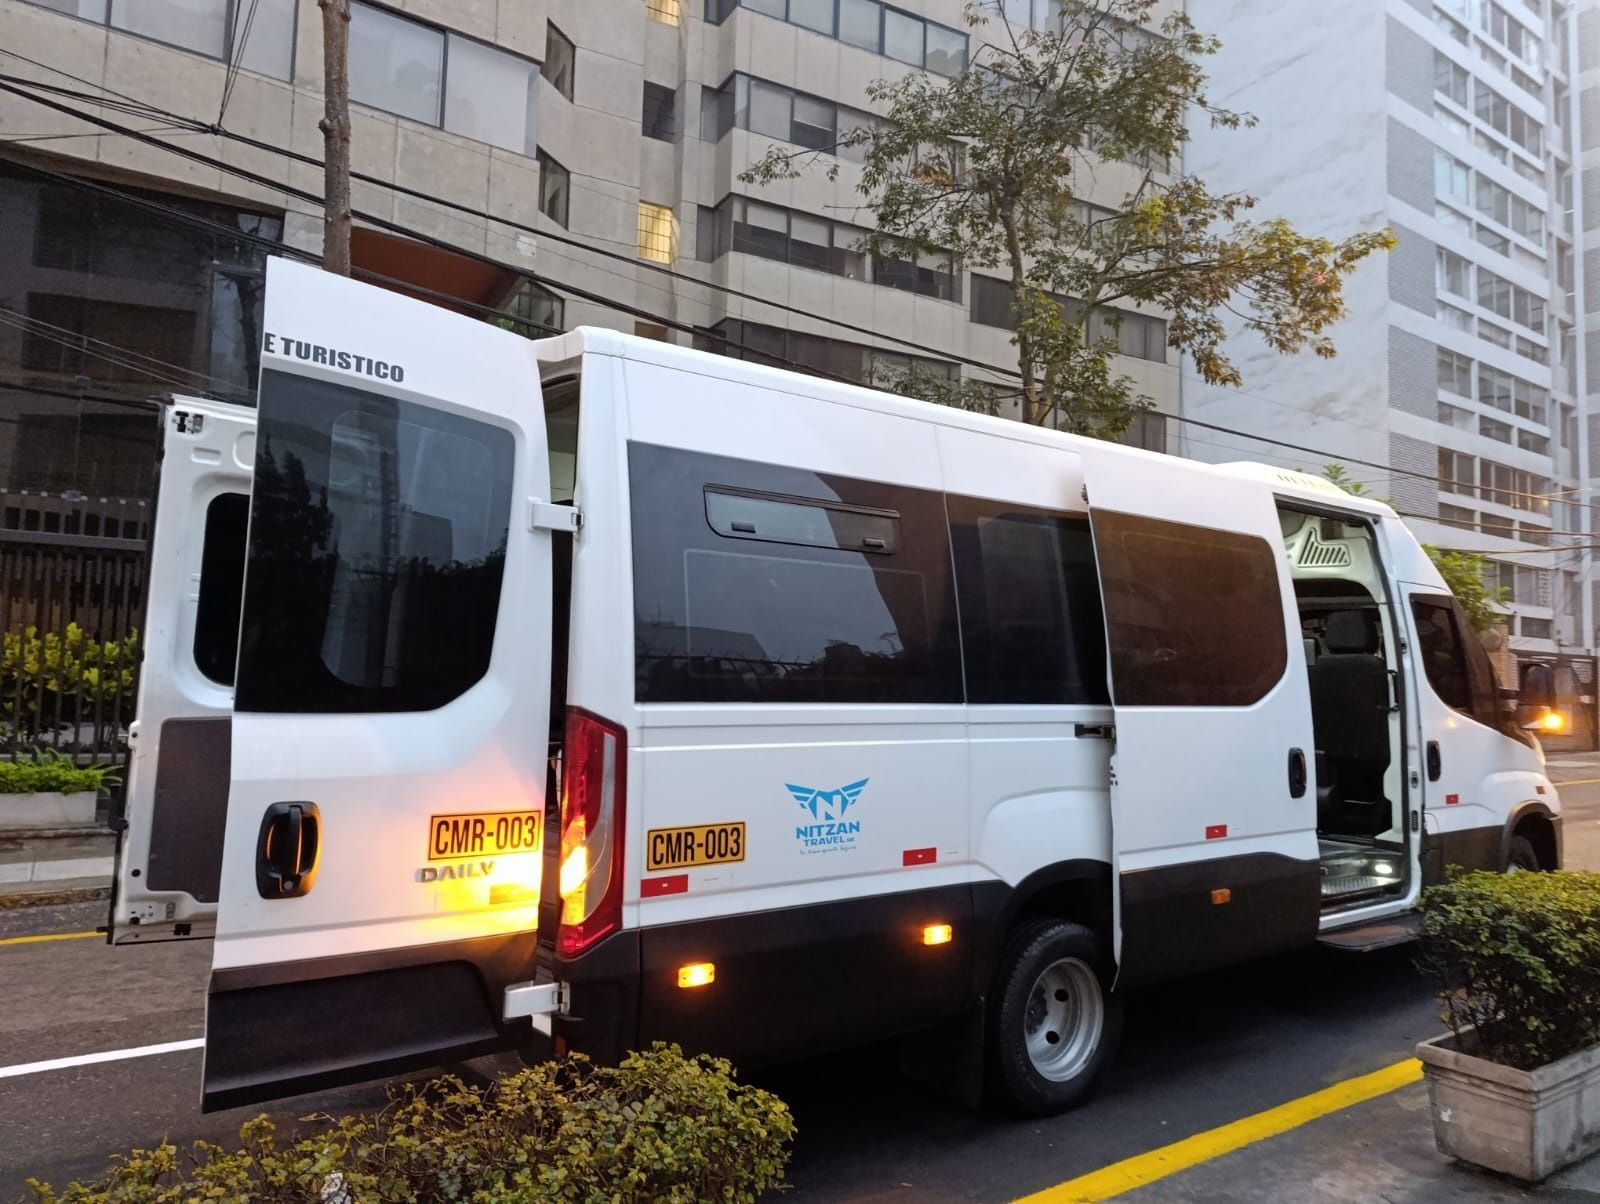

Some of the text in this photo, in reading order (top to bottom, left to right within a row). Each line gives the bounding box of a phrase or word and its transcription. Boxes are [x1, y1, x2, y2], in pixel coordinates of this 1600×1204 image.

[280, 336, 404, 382] TURISTICO
[435, 815, 536, 855] CMR-003
[796, 820, 860, 839] NITZAN
[804, 836, 845, 847] TRAVEL
[652, 827, 741, 865] CMR-003
[415, 861, 495, 883] DAILY
